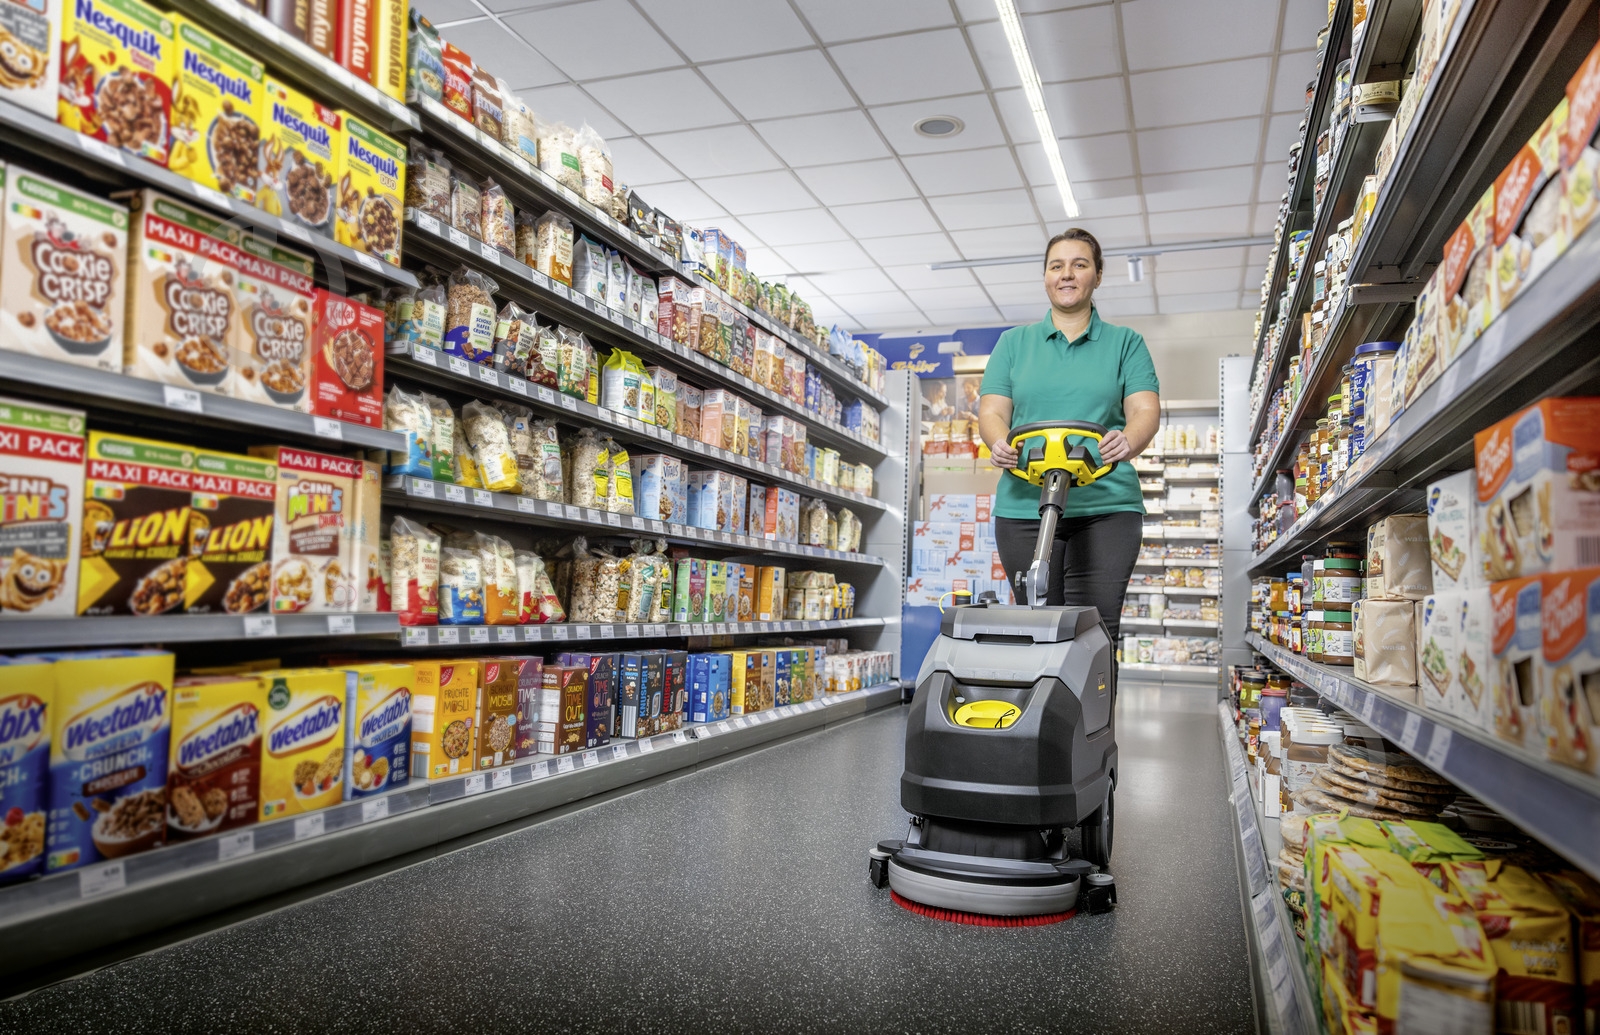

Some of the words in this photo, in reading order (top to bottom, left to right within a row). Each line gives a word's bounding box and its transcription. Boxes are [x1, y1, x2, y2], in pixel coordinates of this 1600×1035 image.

[76, 0, 162, 61] Nesquik
[388, 0, 404, 88] mymues
[184, 48, 252, 105] Nesquik
[273, 102, 331, 148] Nesquik
[348, 136, 399, 179] Nesquik
[380, 174, 397, 190] DUO
[148, 219, 195, 248] MAXI
[200, 237, 241, 266] PACK
[35, 243, 111, 281] Cookie
[238, 255, 276, 281] MAXI
[280, 270, 313, 294] PACK
[168, 283, 228, 316] Cookie
[329, 306, 354, 324] KitKat
[254, 311, 305, 340] Cookie
[28, 436, 82, 458] PACK
[281, 452, 317, 468] MAXI
[321, 458, 355, 474] PACK
[91, 462, 141, 481] MAXI
[147, 470, 190, 487] PACK
[192, 476, 232, 493] MAXI
[236, 483, 273, 497] PACK
[299, 481, 333, 495] CINI
[518, 687, 537, 703] TIME
[566, 693, 582, 706] TIME
[595, 680, 609, 693] TIME
[639, 669, 649, 717] KNUSPER
[663, 667, 673, 713] KNUSPER
[67, 690, 167, 749] Weetabix
[270, 702, 342, 752] Weetabix
[361, 693, 412, 738] Weetabix
[565, 705, 582, 722] OUT
[180, 710, 260, 765] Weetabix
[371, 723, 400, 746] PROTEIN
[79, 747, 147, 782] CRUNCH
